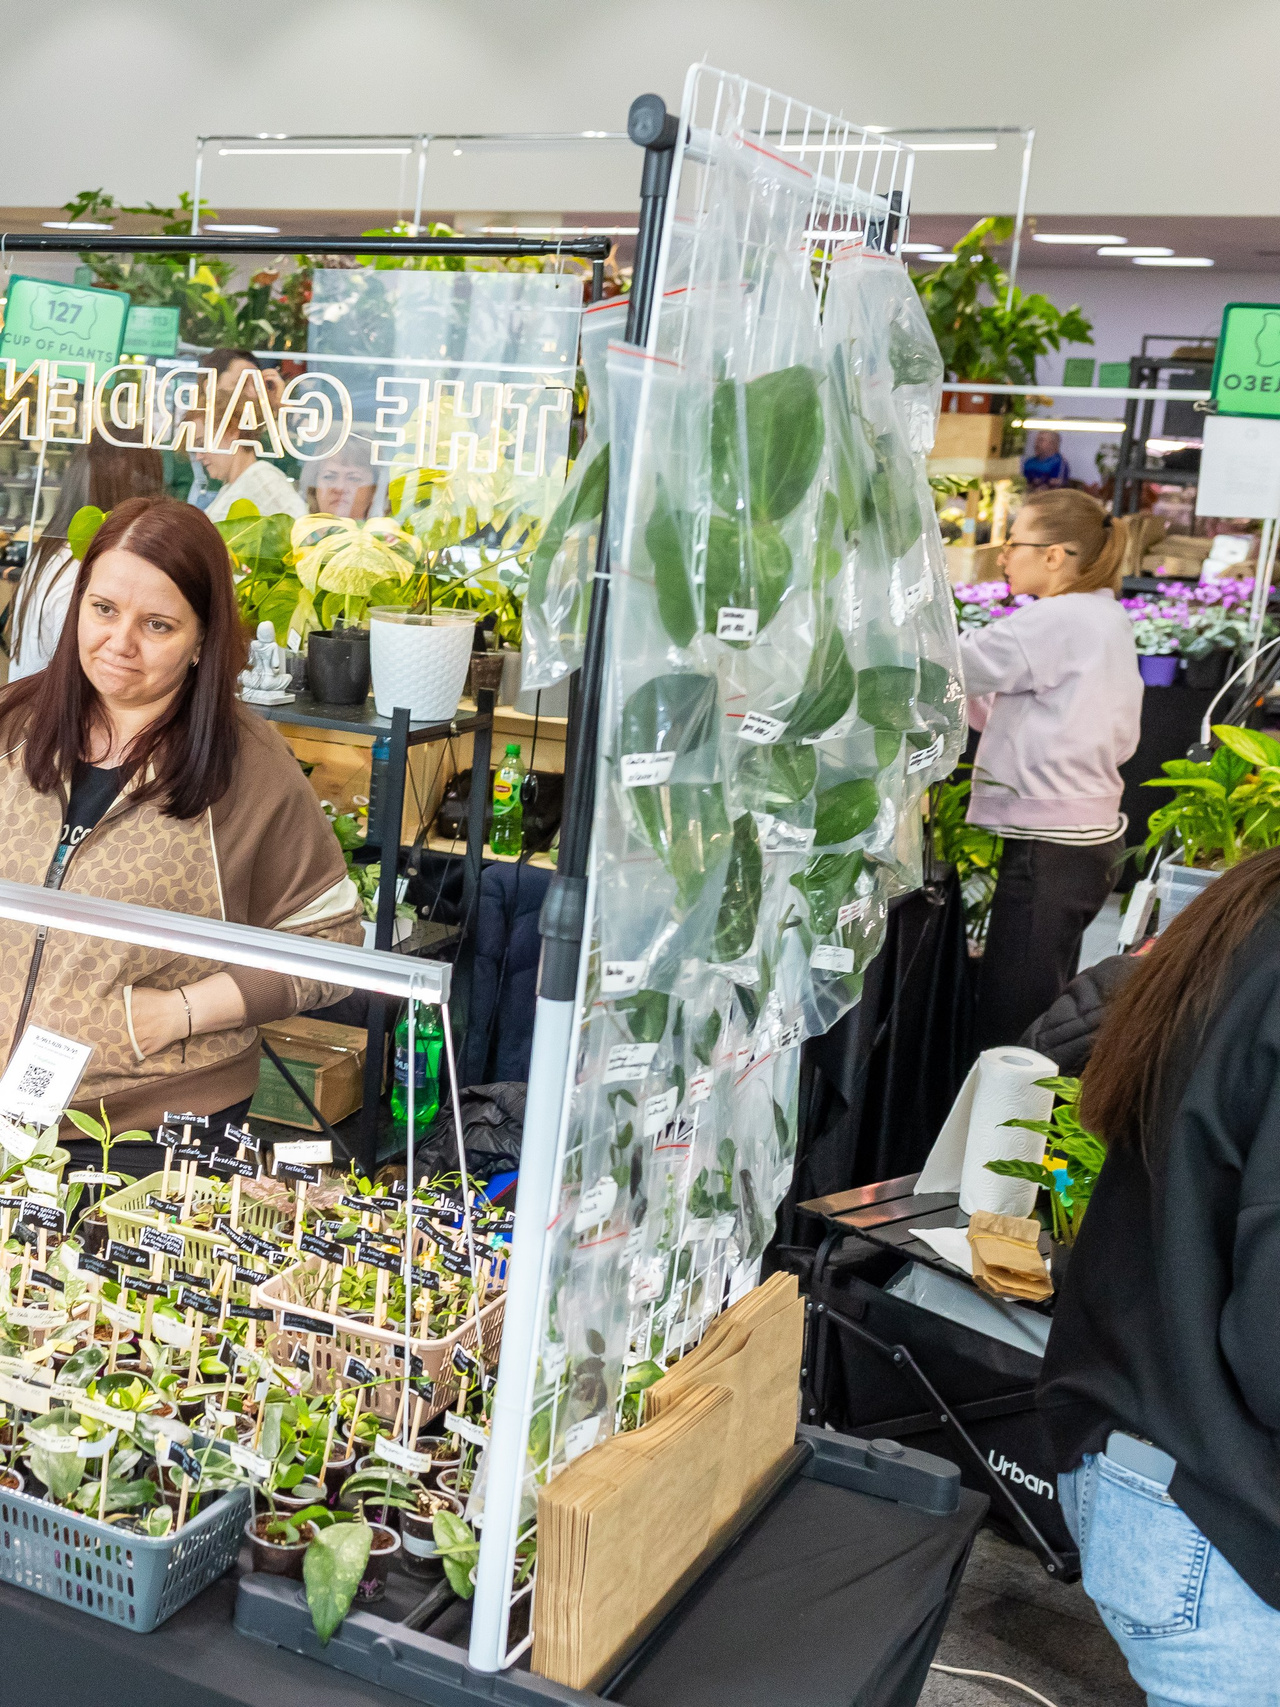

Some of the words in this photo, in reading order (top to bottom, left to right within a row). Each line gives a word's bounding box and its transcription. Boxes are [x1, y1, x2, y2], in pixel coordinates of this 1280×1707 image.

[47, 299, 83, 325] 127
[2, 332, 31, 347] CUP
[37, 338, 54, 353] OF
[59, 343, 114, 363] PLANTS
